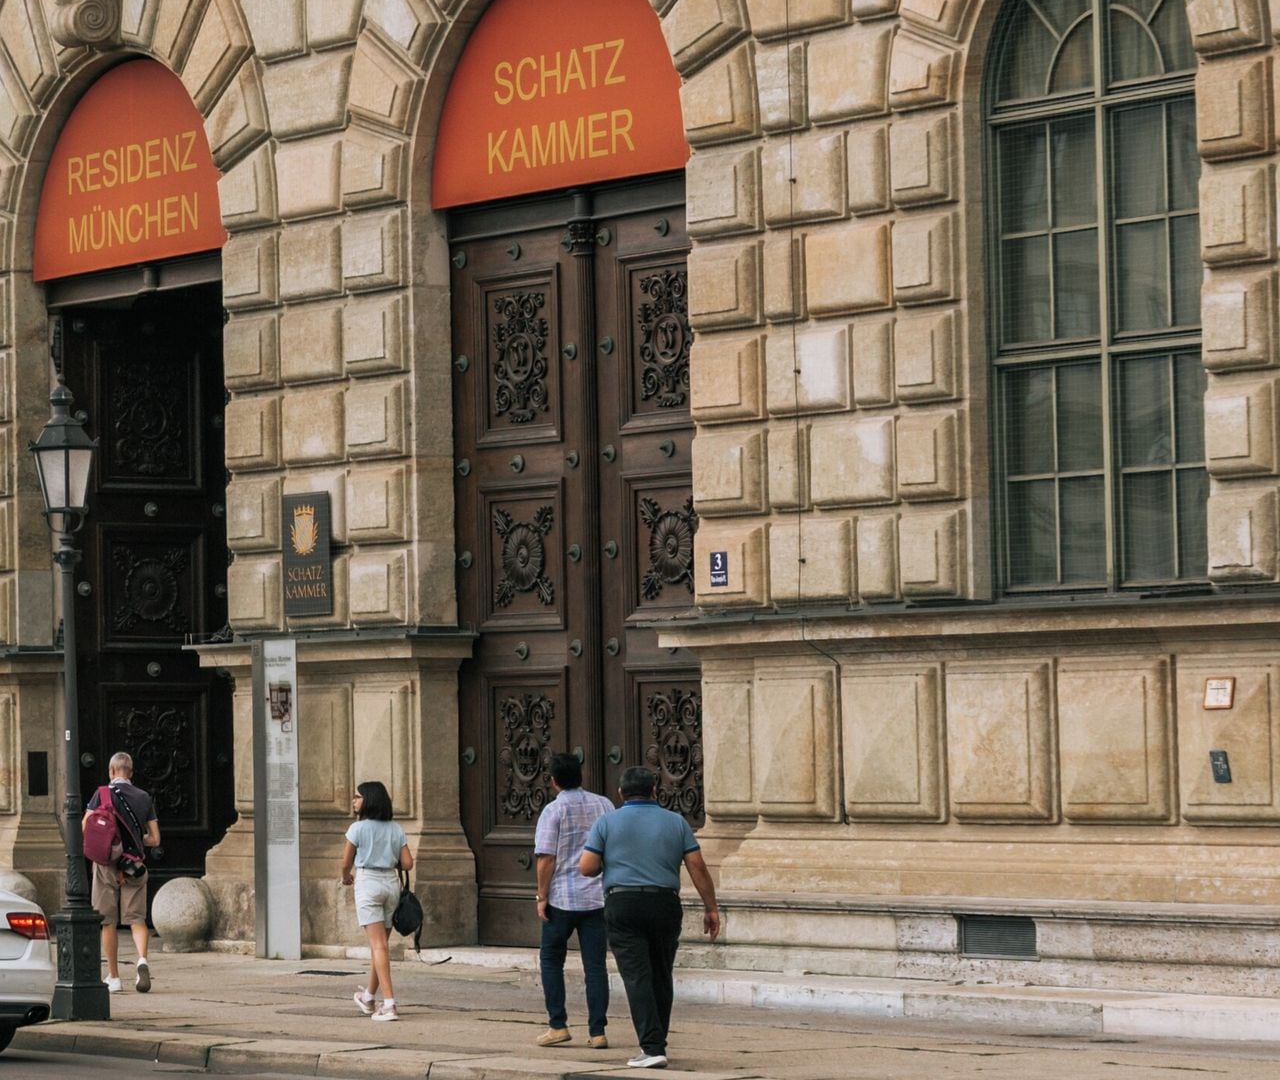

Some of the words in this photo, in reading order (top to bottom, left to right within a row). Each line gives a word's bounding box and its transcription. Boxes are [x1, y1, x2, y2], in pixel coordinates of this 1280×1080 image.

[493, 38, 626, 105] SCHATZ
[68, 130, 198, 195] RESIDENZ
[487, 108, 635, 175] KAMMER
[69, 191, 198, 254] MÜNCHEN
[285, 582, 327, 599] KAMMER
[714, 553, 722, 570] 3
